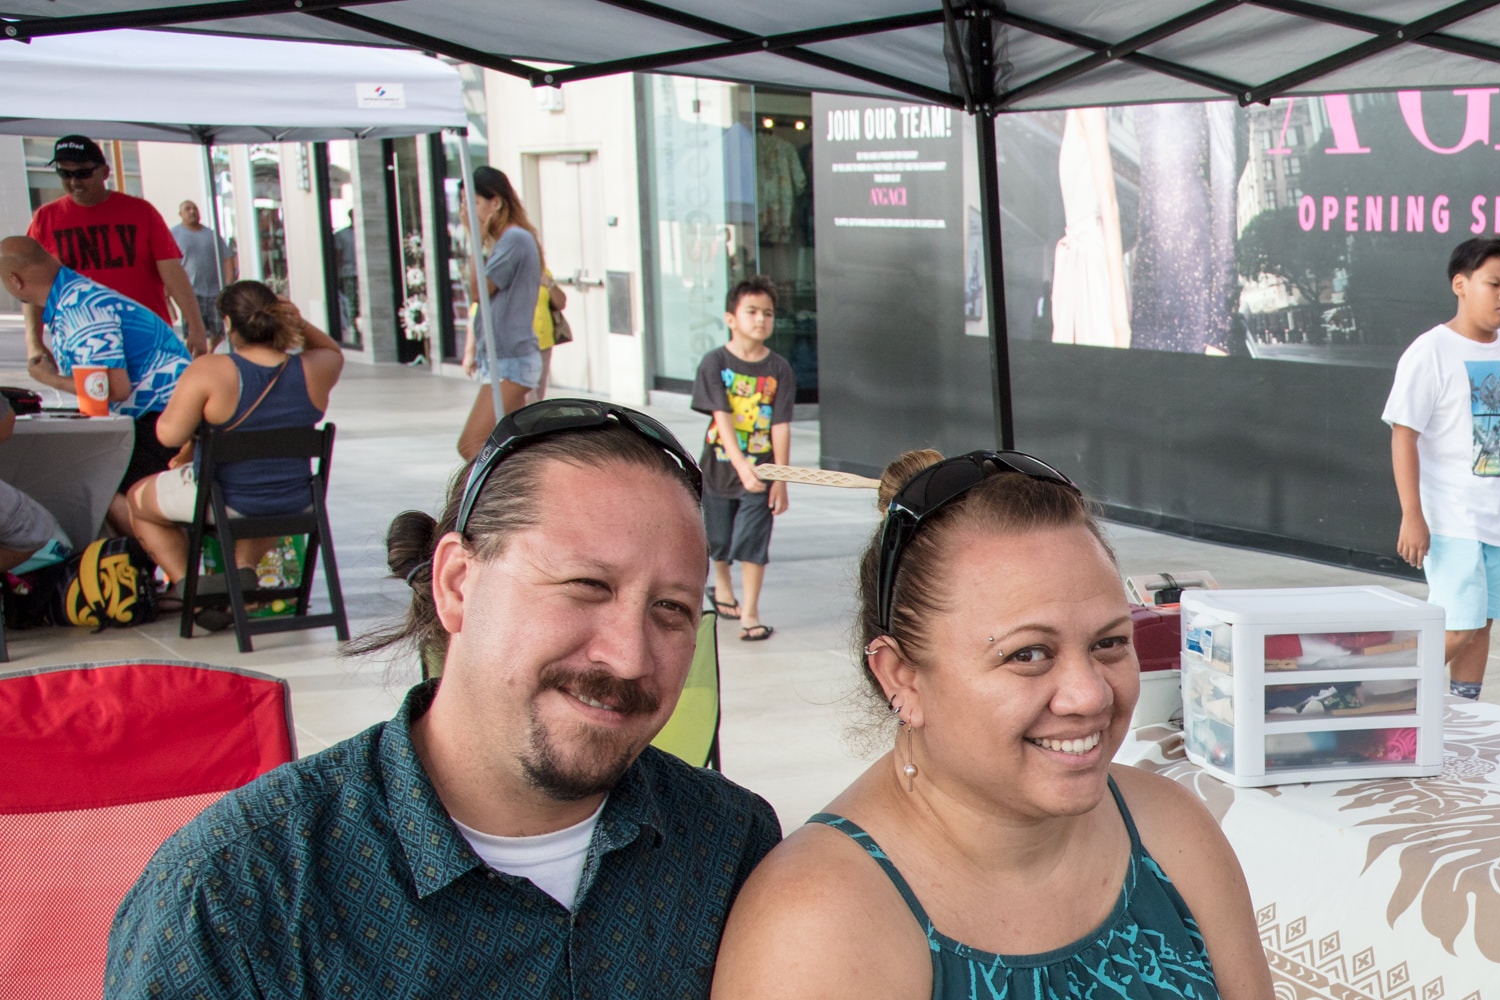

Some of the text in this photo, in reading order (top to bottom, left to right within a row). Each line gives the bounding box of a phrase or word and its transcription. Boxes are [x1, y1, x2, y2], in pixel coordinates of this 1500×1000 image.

[827, 105, 952, 141] JOIN OUR TEAM!
[1299, 195, 1450, 233] OPENING
[54, 224, 138, 269] UNLV
